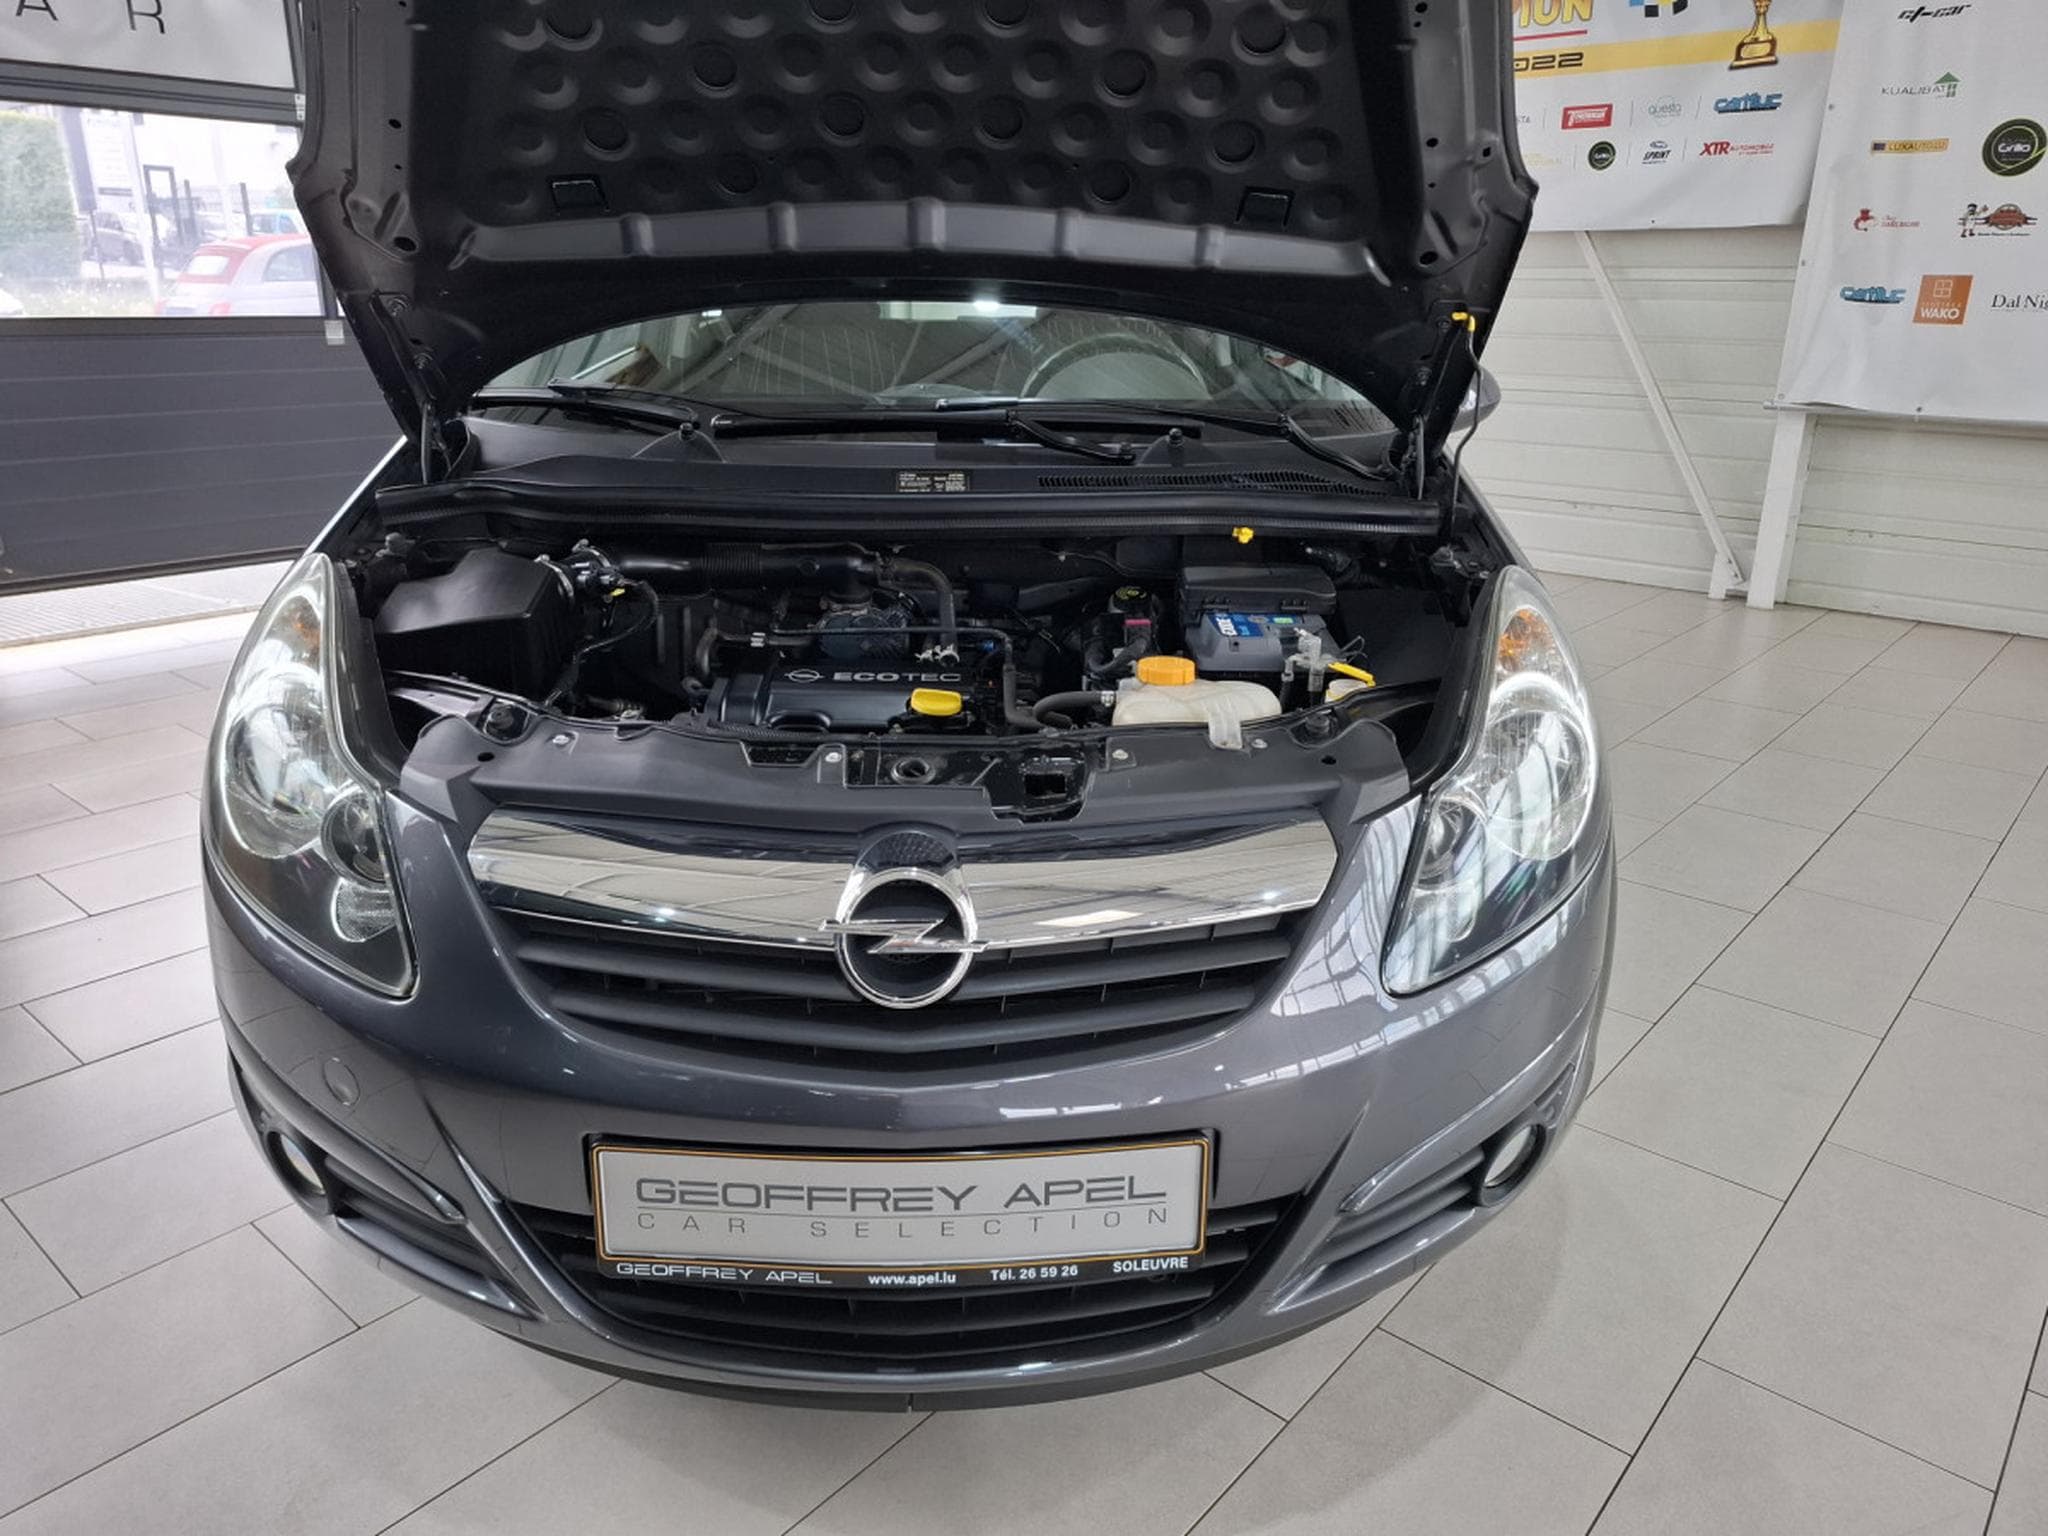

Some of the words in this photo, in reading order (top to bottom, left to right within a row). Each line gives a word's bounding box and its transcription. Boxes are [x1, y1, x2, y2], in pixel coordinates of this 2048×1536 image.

[1700, 141, 1731, 156] XTR
[1991, 294, 2021, 308] Dal
[1920, 307, 1961, 320] WAKO
[833, 671, 962, 683] ECOTEC
[636, 1178, 977, 1213] GEOFFREY
[1003, 1176, 1167, 1209] APEL
[637, 1212, 746, 1234] CAR
[810, 1208, 1167, 1239] SELECTION
[616, 1262, 753, 1281] GEOFFREY
[765, 1270, 832, 1285] APEL
[867, 1271, 956, 1287] www.apel.lu
[990, 1268, 1016, 1281] Tél.
[1020, 1268, 1036, 1281] 26
[1039, 1266, 1058, 1280] 59
[1060, 1264, 1079, 1278] 26
[1112, 1255, 1190, 1274] SOLEUVRE
